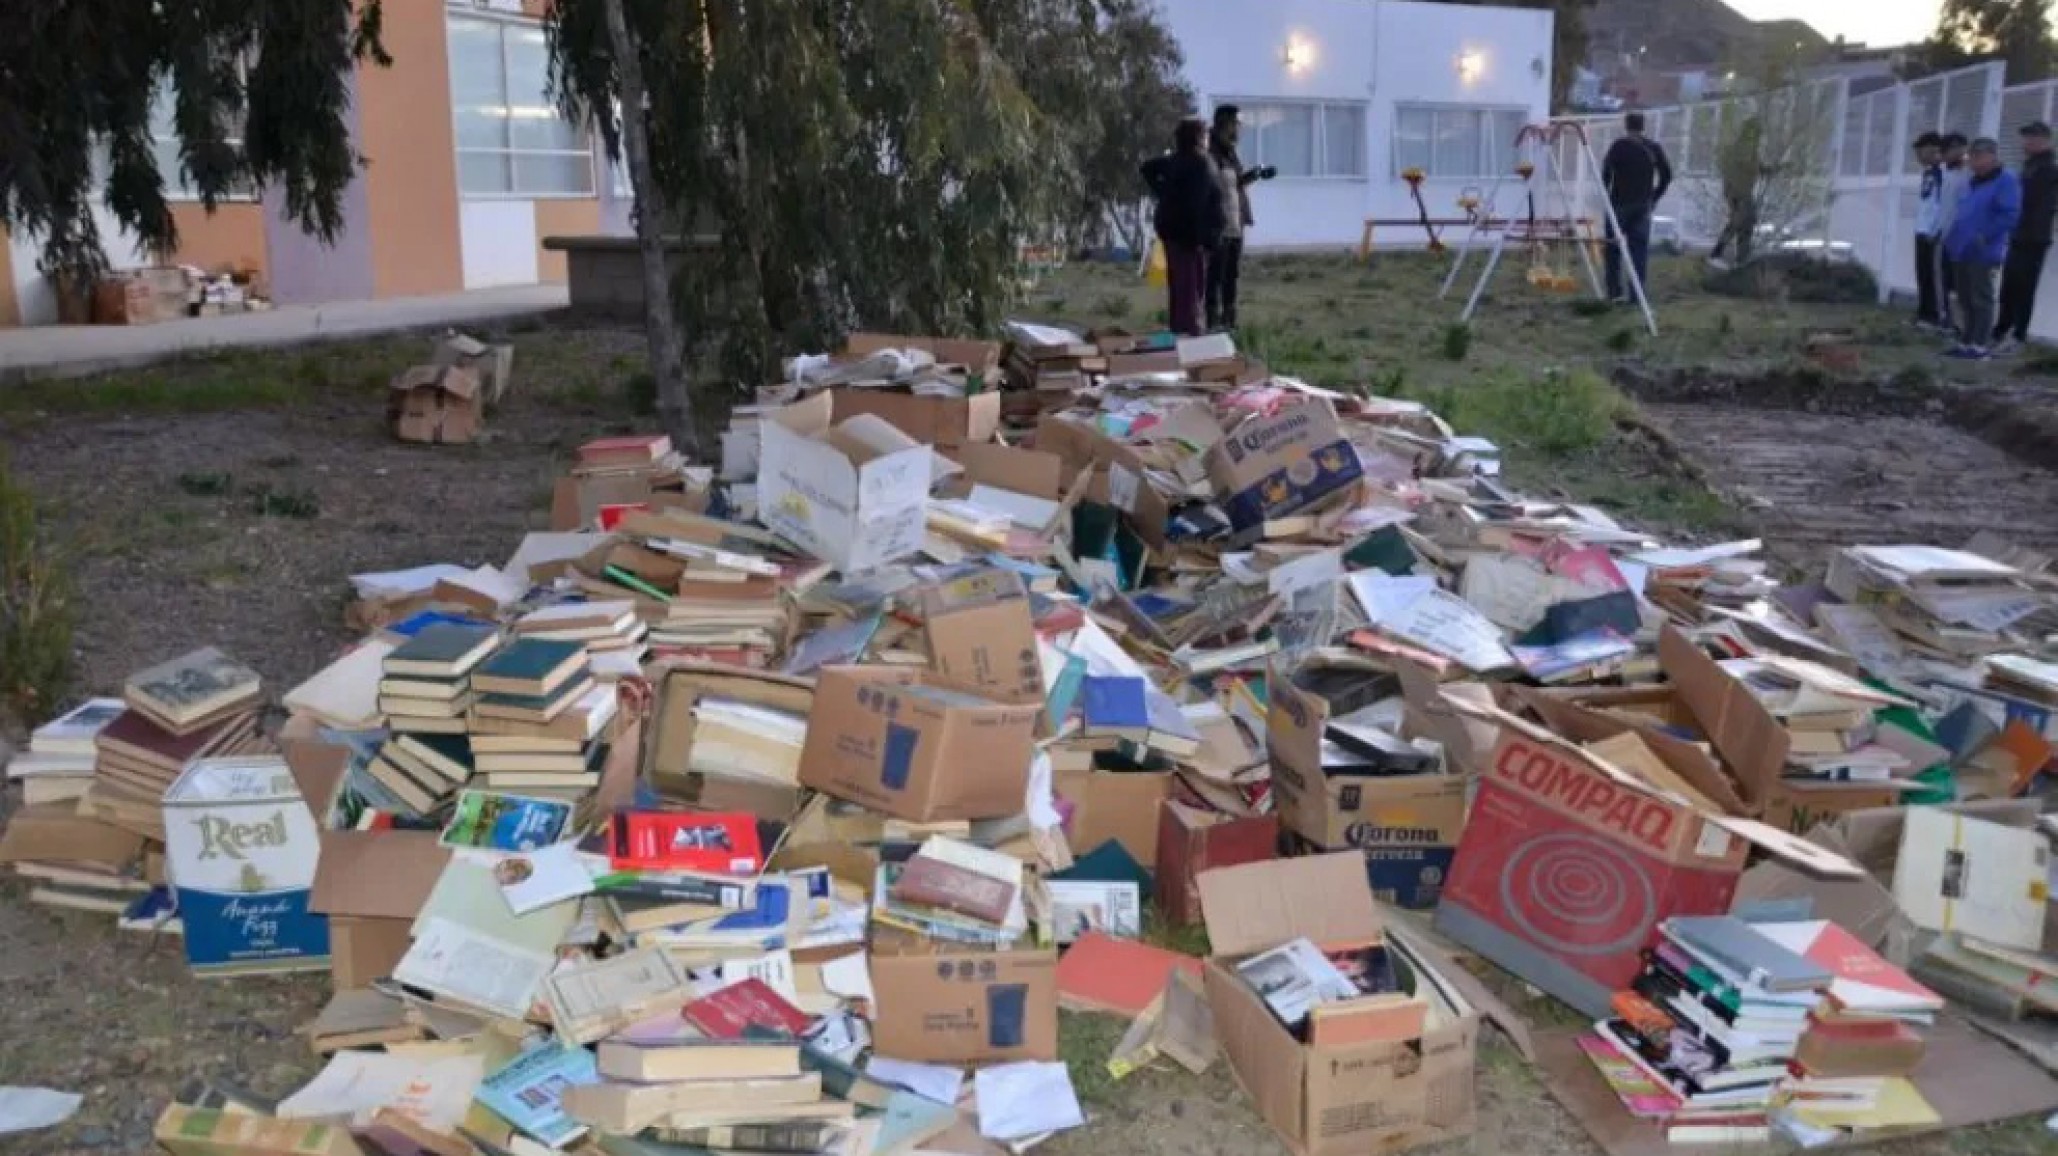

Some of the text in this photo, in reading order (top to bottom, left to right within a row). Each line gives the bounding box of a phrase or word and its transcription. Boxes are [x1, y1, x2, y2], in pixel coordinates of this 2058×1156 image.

[1496, 742, 1673, 850] COMPAQ
[190, 810, 288, 860] Real
[1344, 822, 1439, 847] Corona
